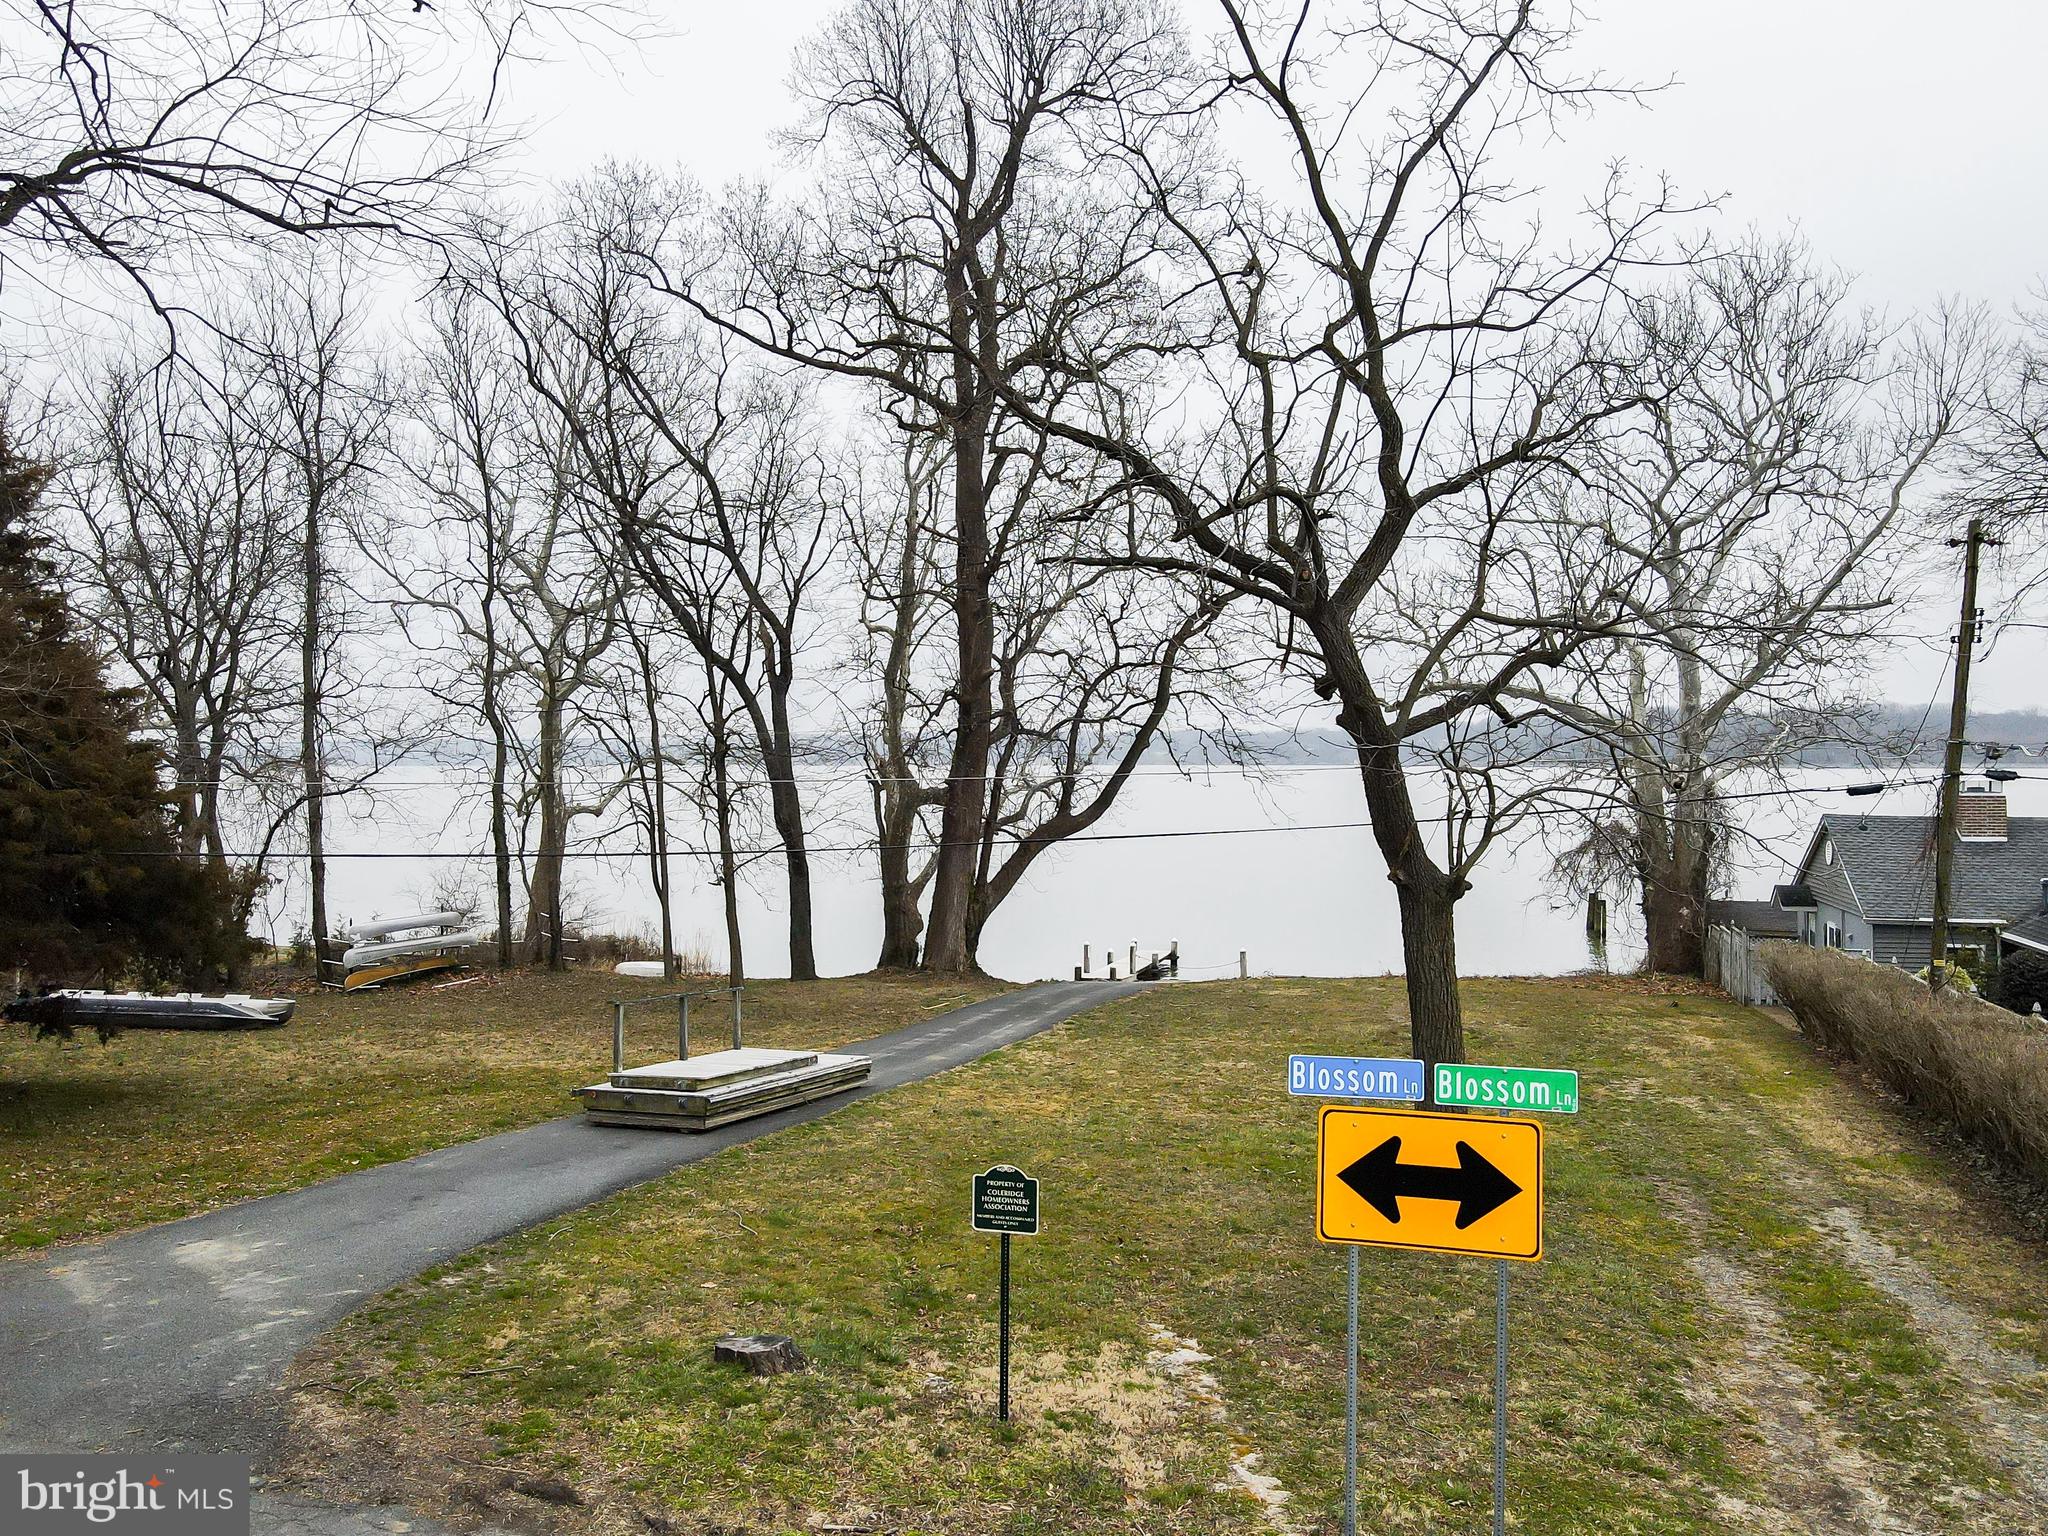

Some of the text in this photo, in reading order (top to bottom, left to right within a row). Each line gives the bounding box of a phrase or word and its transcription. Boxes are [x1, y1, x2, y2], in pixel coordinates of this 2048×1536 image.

[1293, 1060, 1418, 1094] Blossom Ln
[1439, 1069, 1550, 1105] Blossom
[1556, 1089, 1572, 1106] Ln
[987, 1189, 1024, 1197] COLERIDGE
[981, 1195, 1030, 1205] HOMEOWNERS
[983, 1203, 1028, 1212] ASSOCIATION
